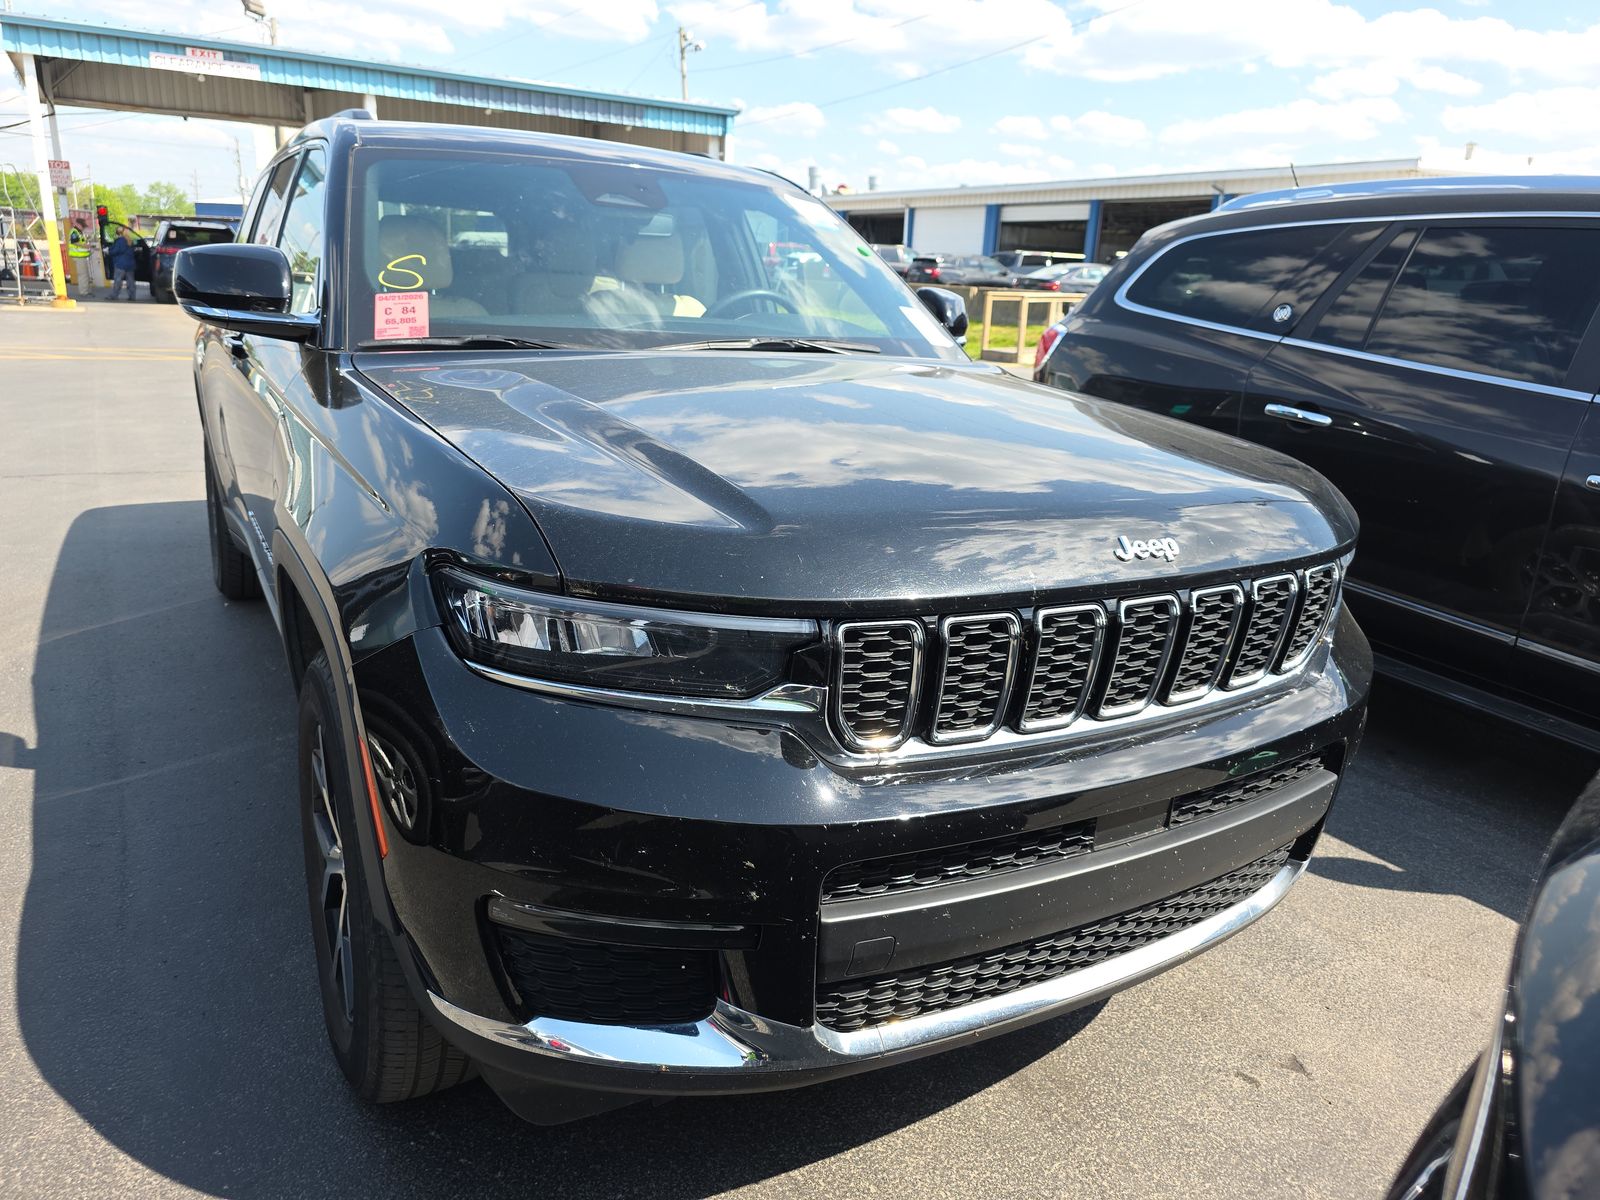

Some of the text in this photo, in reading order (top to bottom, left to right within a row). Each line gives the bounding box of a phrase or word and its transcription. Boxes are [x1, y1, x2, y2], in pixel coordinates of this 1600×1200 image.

[191, 48, 218, 58] EXIT
[378, 255, 426, 289] S
[385, 306, 416, 315] C 84
[1114, 535, 1180, 562] Jeep
